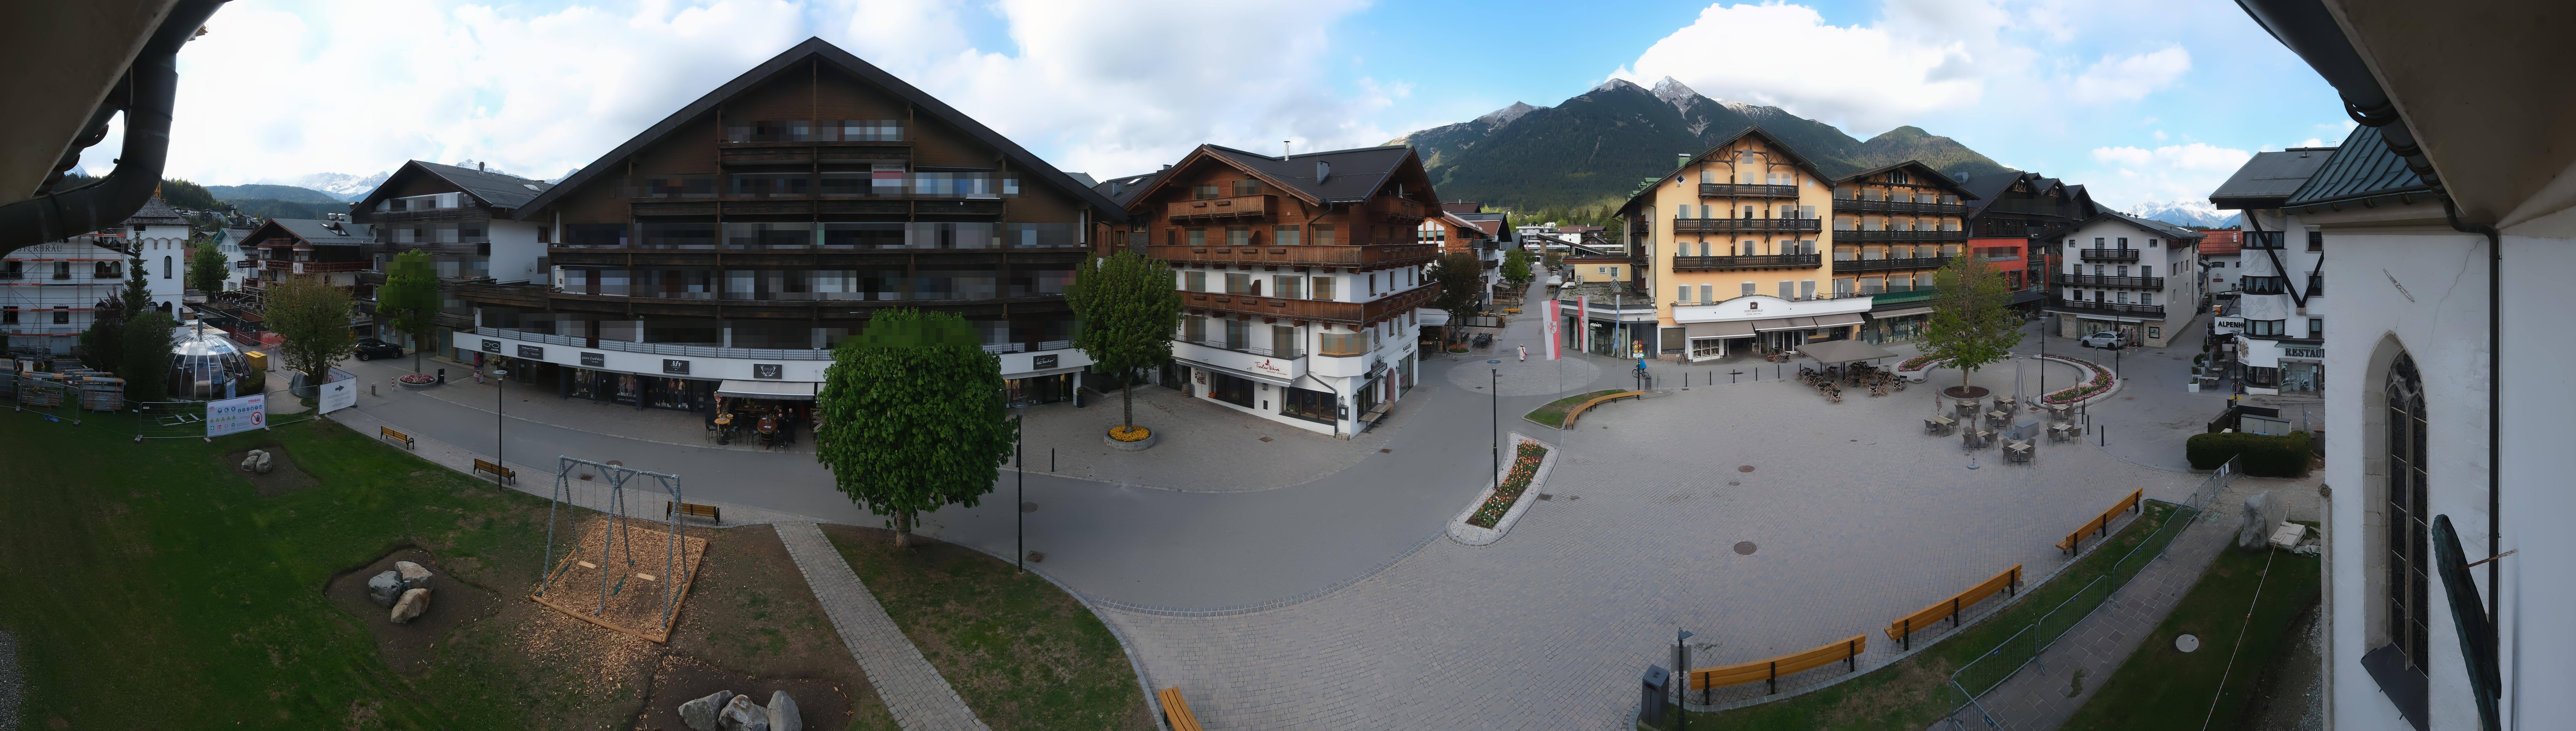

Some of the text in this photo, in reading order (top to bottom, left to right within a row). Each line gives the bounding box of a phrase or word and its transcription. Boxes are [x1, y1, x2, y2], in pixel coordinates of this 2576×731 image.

[1403, 343, 1411, 352] SAILER
[671, 361, 682, 370] My
[1372, 364, 1386, 377] RESTAURANT
[327, 395, 351, 404] KONGRESSZENTRUM
